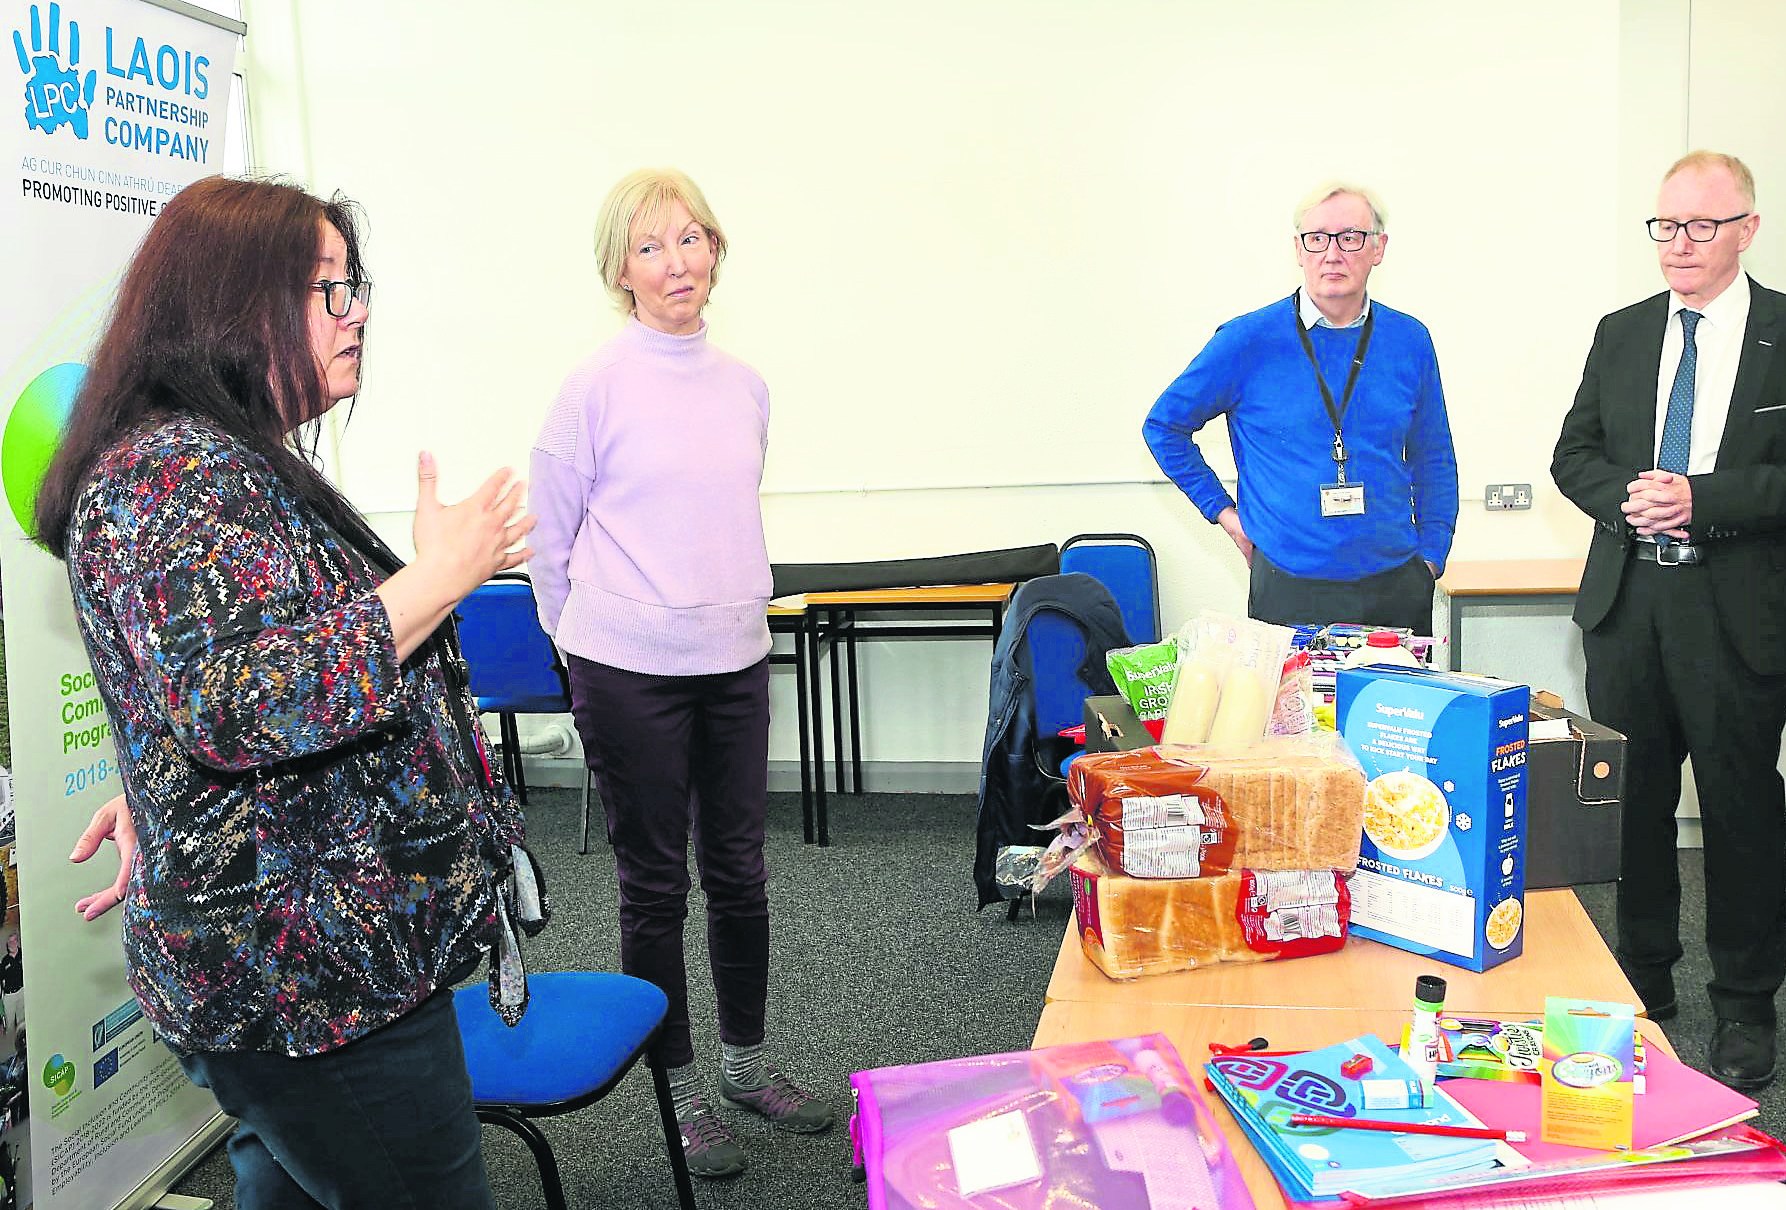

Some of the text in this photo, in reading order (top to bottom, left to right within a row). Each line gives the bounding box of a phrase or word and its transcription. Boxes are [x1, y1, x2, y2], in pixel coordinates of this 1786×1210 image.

[106, 26, 210, 99] LAOIS
[29, 81, 78, 118] LPC
[106, 86, 209, 129] PARTNERSHIP
[105, 116, 209, 164] COMPANY
[22, 156, 36, 171] AG
[41, 160, 62, 175] CUR
[65, 164, 95, 181] CHUN
[99, 171, 121, 186] CINN
[23, 179, 157, 217] PROMOTING POSITIVE
[1126, 662, 1176, 681] SuperValu
[1376, 703, 1425, 720] SuperValu
[1498, 714, 1524, 728] SuperValu
[1491, 752, 1526, 773] FLAKES
[1496, 740, 1526, 756] FROSTED
[65, 759, 119, 796] 2018-
[1358, 857, 1444, 887] FROSTED FLAKES
[50, 1066, 69, 1084] SICAP
